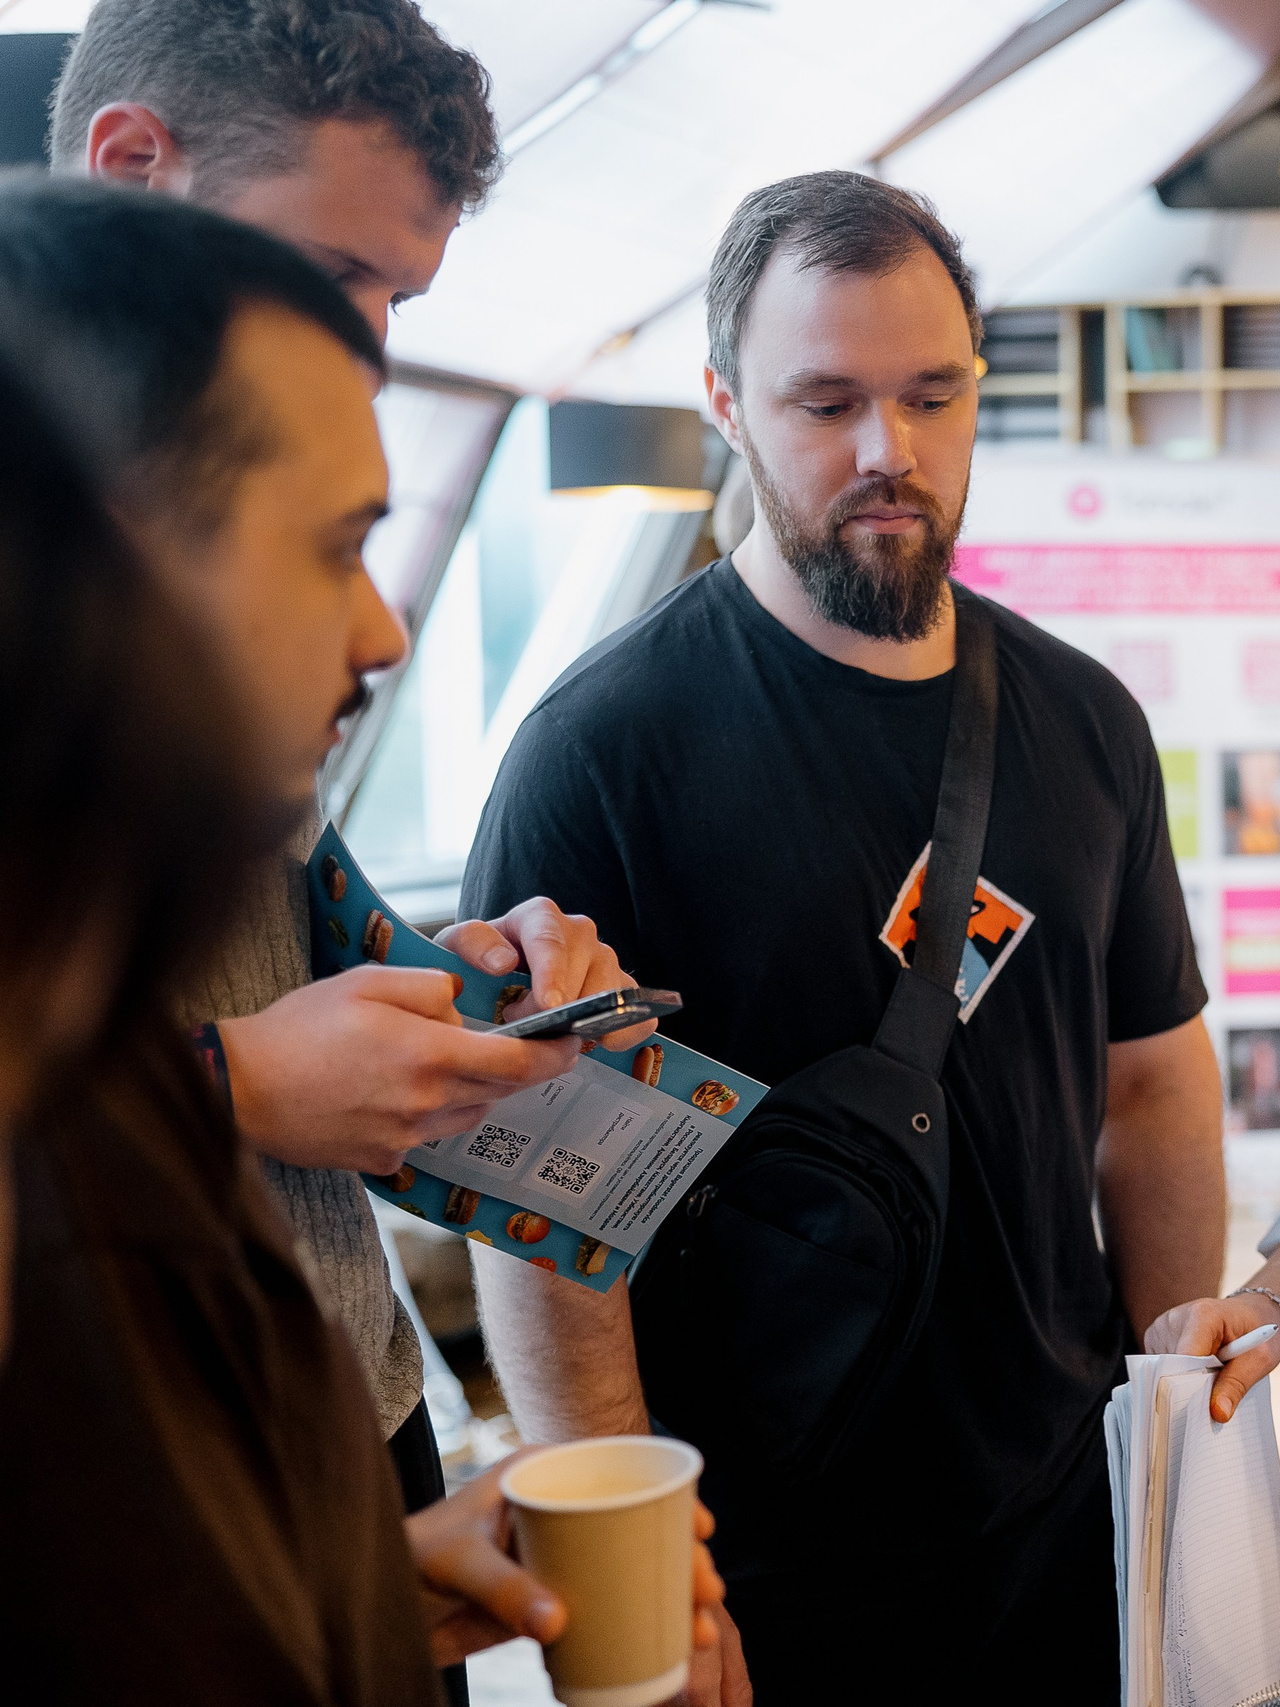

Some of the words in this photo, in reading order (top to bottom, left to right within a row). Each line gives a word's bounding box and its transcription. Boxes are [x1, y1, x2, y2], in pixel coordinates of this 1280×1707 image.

[544, 1085, 565, 1106] Оставить
[595, 1112, 626, 1145] дистрибьютора
[619, 1116, 634, 1130] Найти
[674, 1128, 693, 1147] России,
[676, 1131, 702, 1161] реализуется
[656, 1146, 678, 1171] Беларуси,
[665, 1160, 679, 1175] через
[678, 1147, 703, 1175] Продукция
[634, 1170, 660, 1199] Казахстане,
[660, 1173, 682, 1197] Bagerstat
[629, 1174, 669, 1221] дистрибьюторскую
[640, 1196, 665, 1224] Foodservice
[598, 1209, 618, 1230] Молдове
[611, 1198, 639, 1230] Узбекистане,
[622, 1220, 633, 1231] сеть
